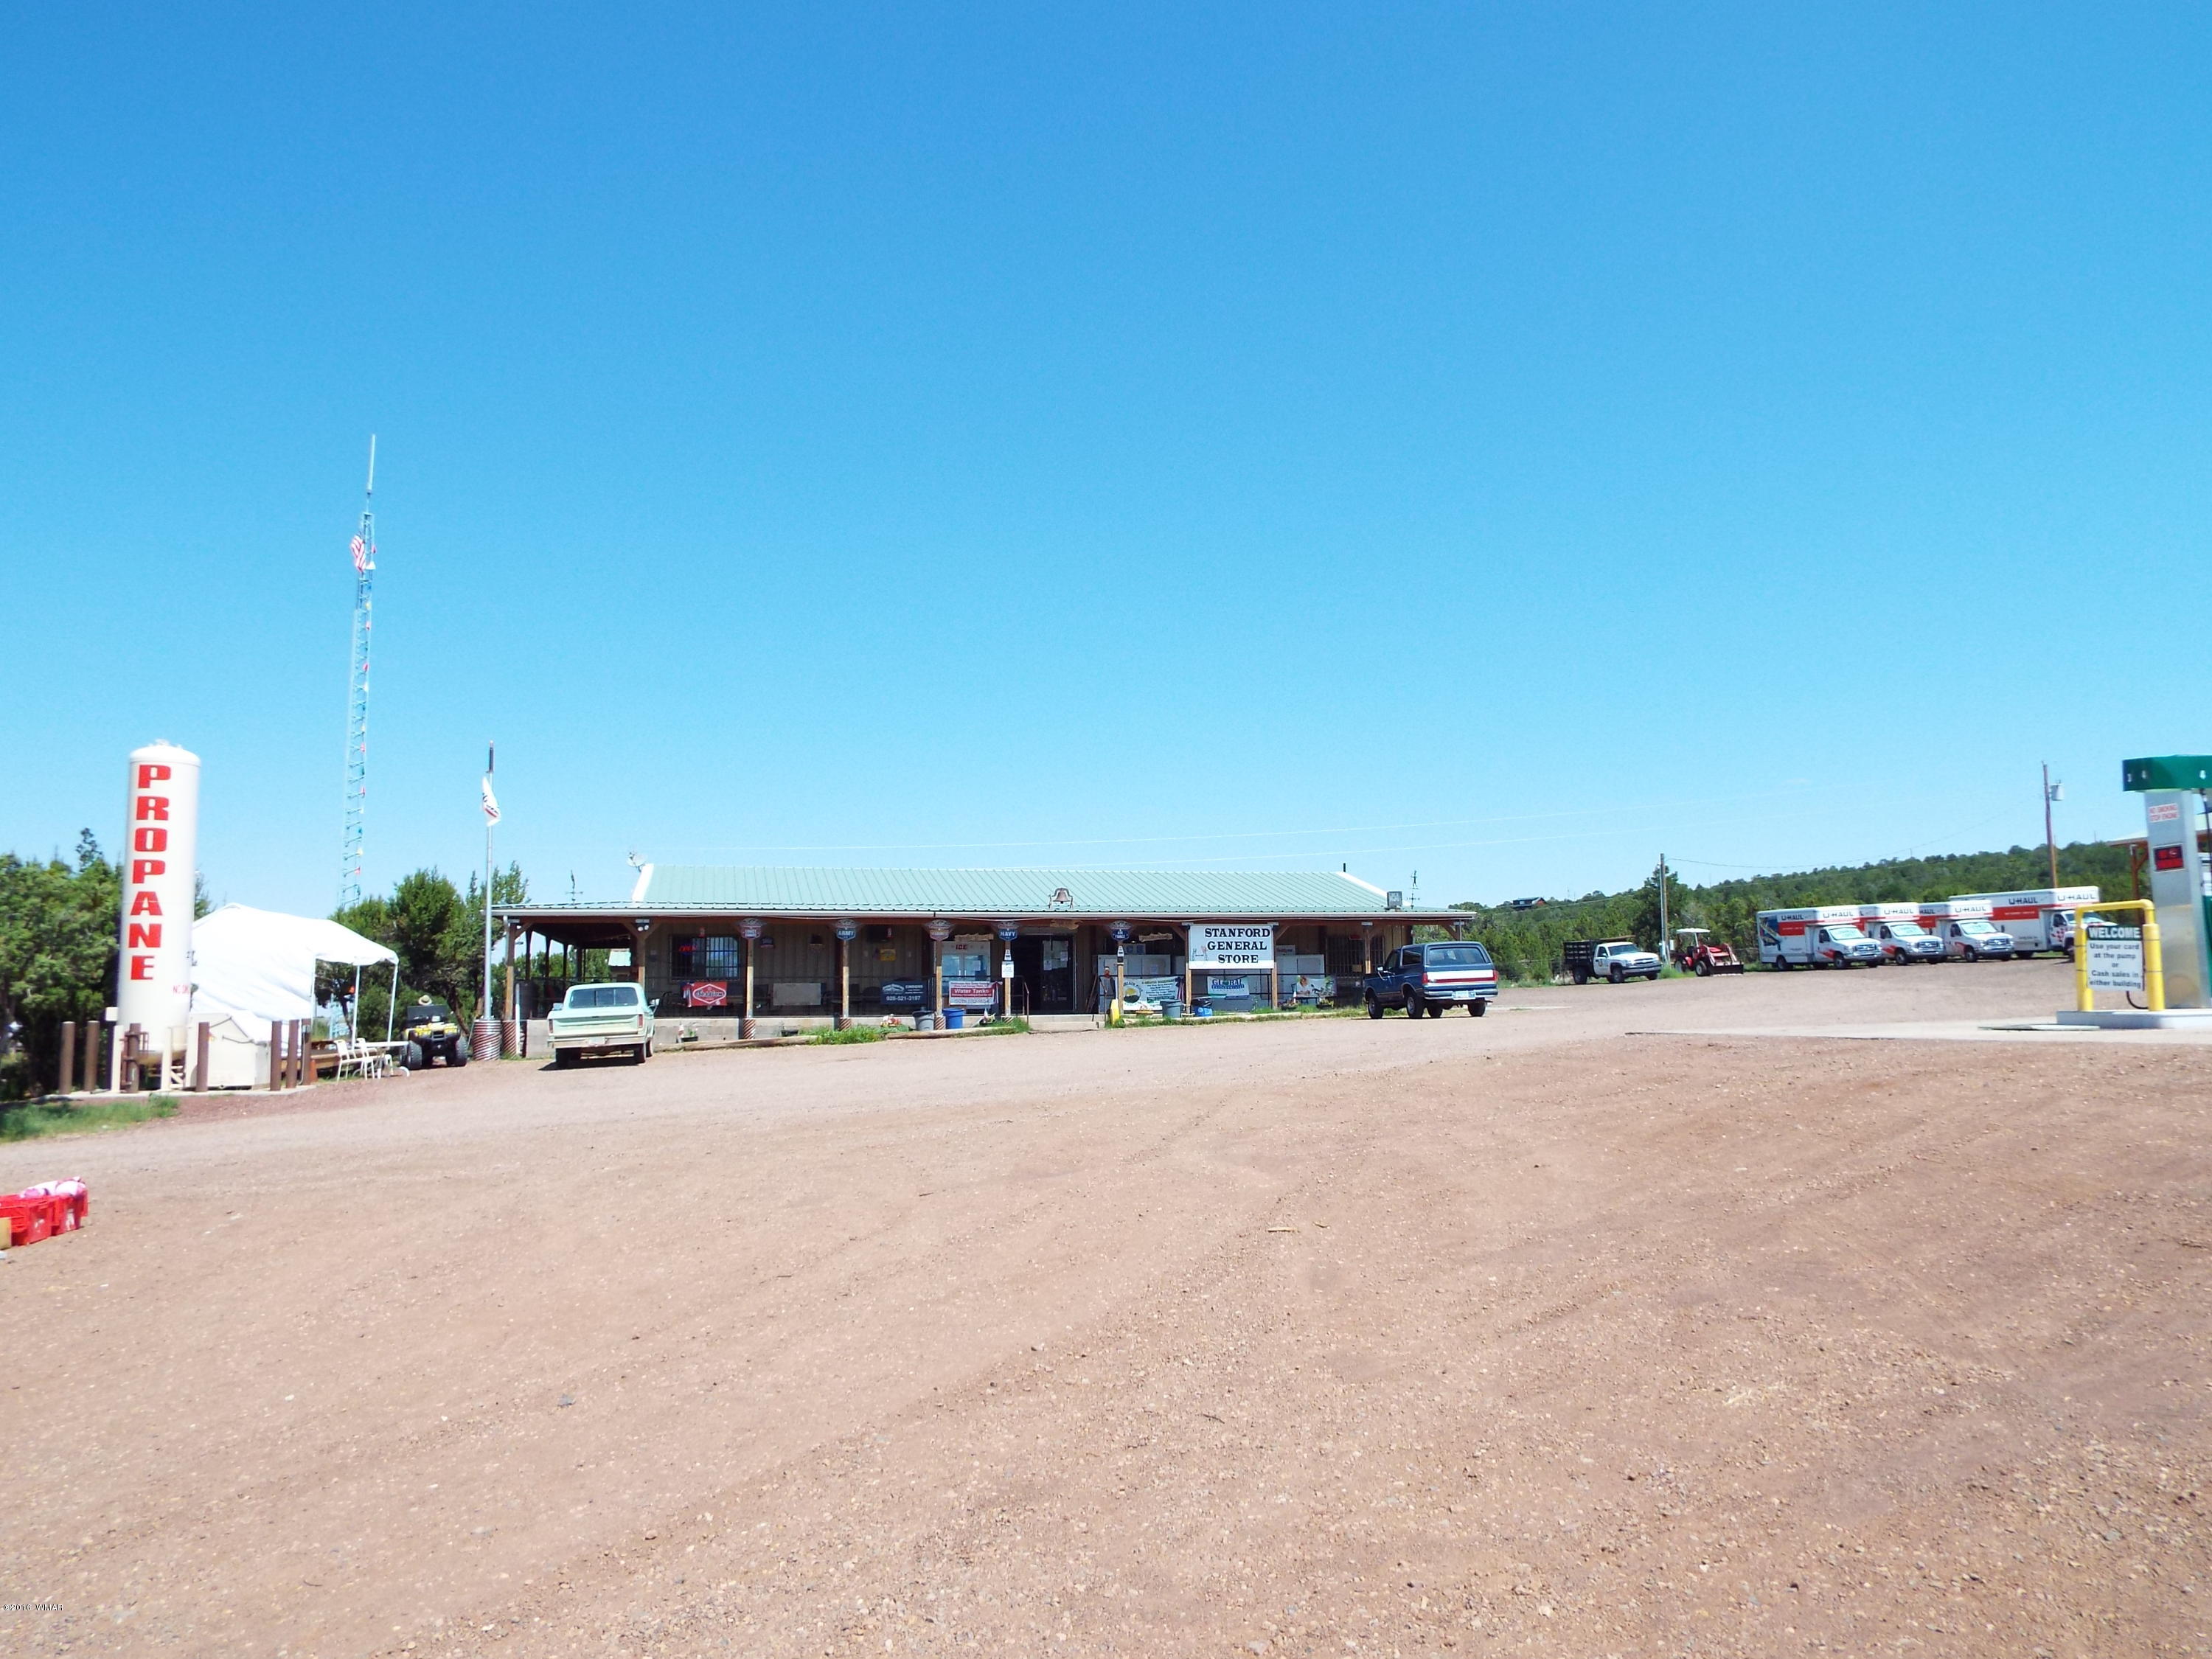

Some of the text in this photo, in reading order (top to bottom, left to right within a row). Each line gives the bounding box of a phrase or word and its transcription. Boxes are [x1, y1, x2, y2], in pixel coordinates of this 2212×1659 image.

[128, 764, 171, 981] PROPANE
[2008, 897, 2038, 905] U-HAUL
[1205, 928, 1270, 937] STANFORD
[2088, 928, 2140, 939] WELCOME
[1207, 942, 1267, 950] GENERAL
[1218, 955, 1259, 963] STORE
[2112, 981, 2141, 989] building
